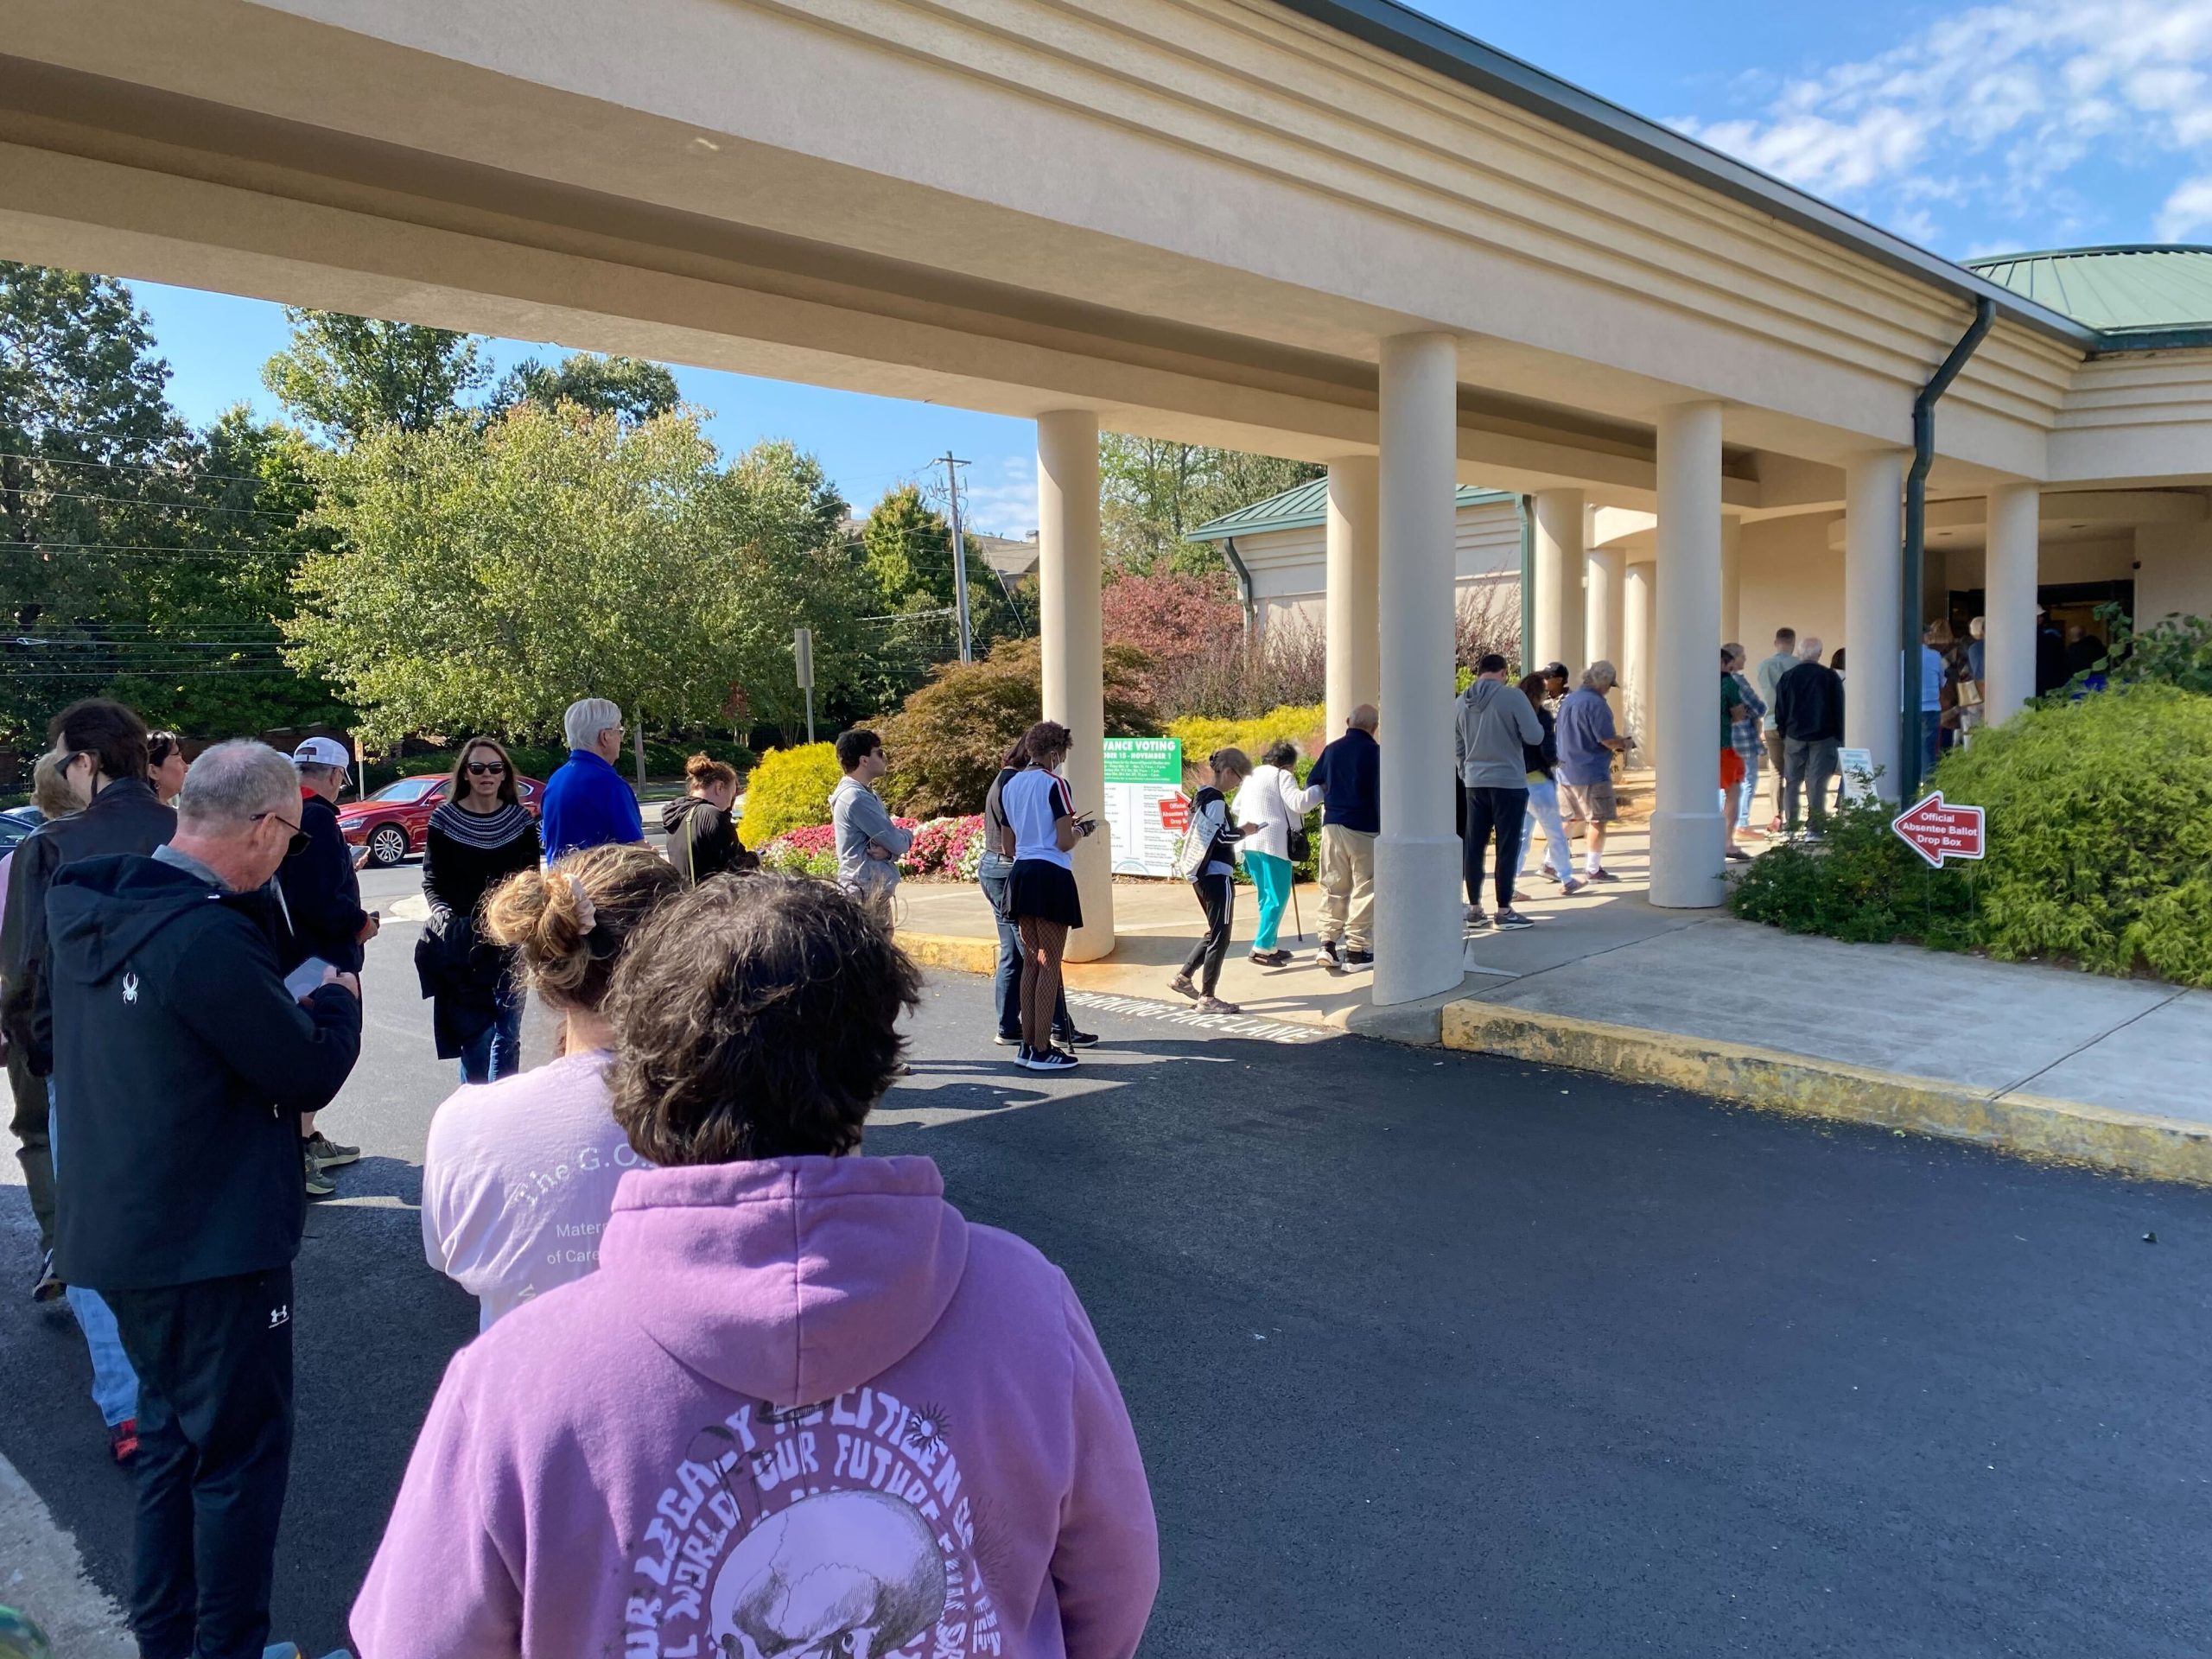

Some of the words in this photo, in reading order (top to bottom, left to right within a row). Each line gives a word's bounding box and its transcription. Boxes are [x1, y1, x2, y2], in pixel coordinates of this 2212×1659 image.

[1103, 741, 1133, 751] VANCE
[1135, 741, 1176, 752] VOTING
[1921, 812, 1955, 823] Official
[1903, 823, 1947, 834] Absentee
[1948, 826, 1978, 836] Ballot
[1917, 835, 1941, 845] Drop
[1942, 836, 1962, 847] Box
[1155, 1009, 1244, 1027] FIRE
[1219, 1020, 1325, 1042] LANE
[515, 1164, 571, 1206] The
[580, 1142, 658, 1171] G.O.
[547, 1249, 562, 1265] of
[566, 1249, 600, 1263] Care
